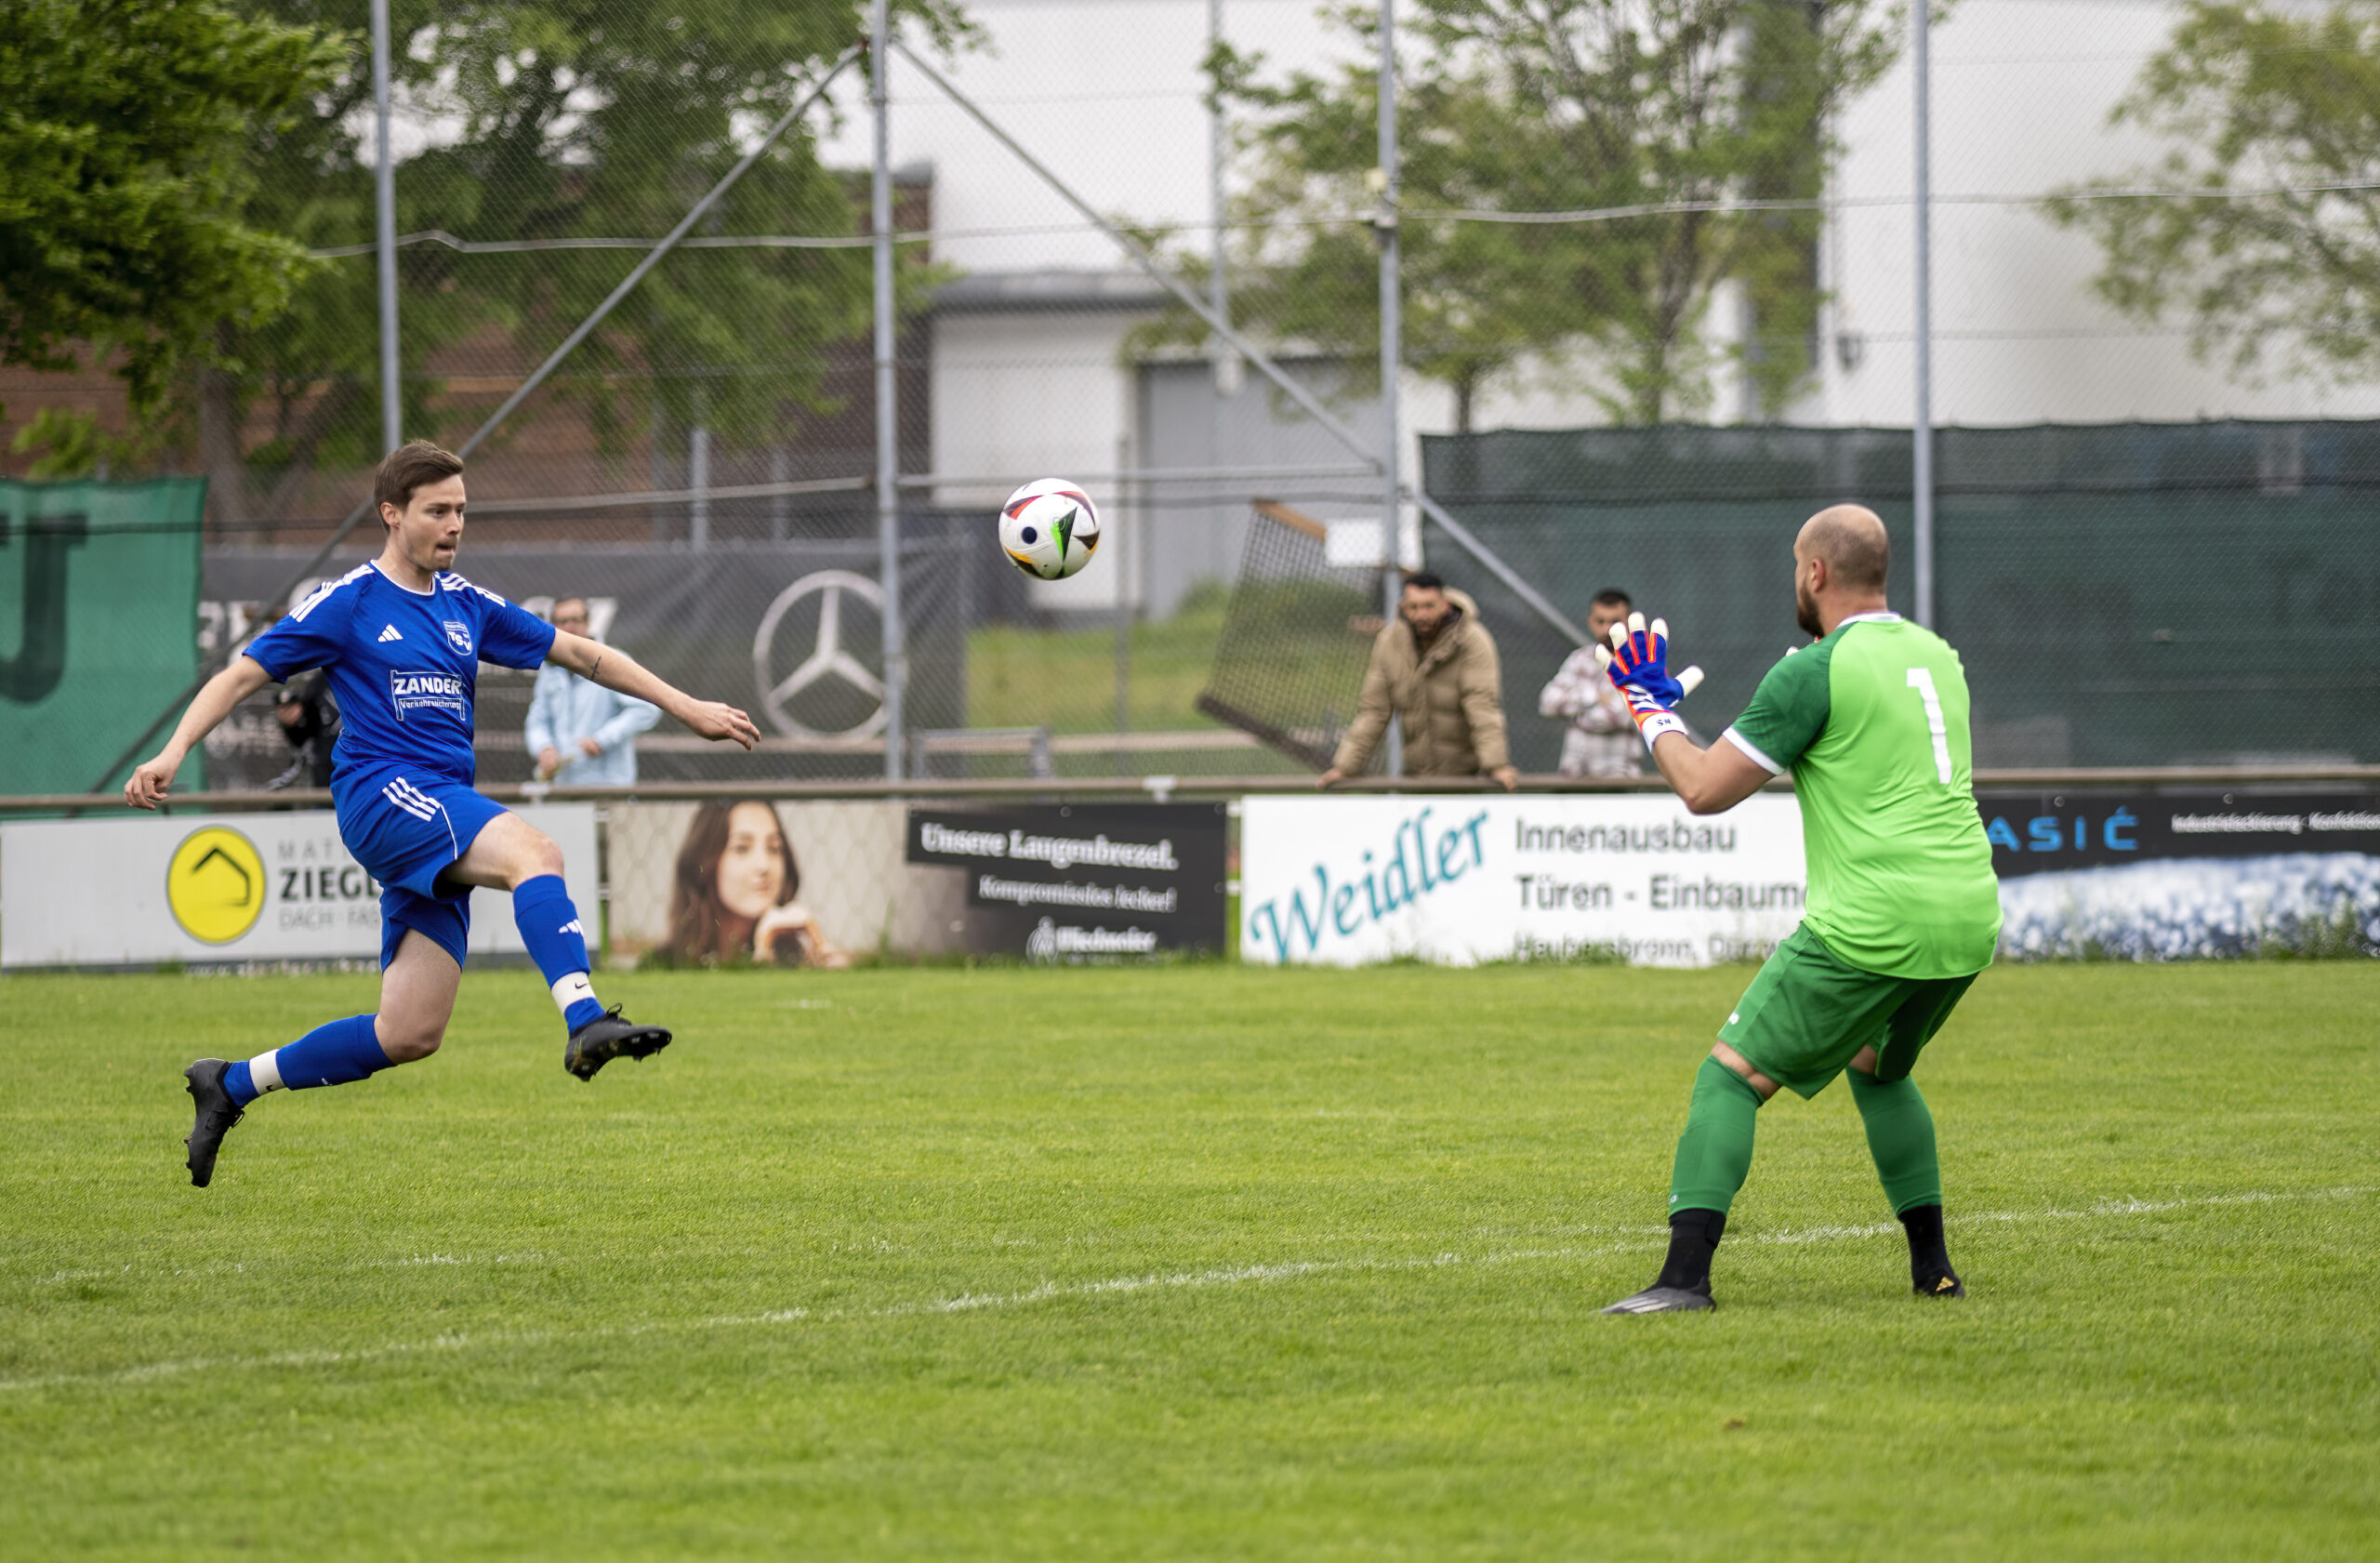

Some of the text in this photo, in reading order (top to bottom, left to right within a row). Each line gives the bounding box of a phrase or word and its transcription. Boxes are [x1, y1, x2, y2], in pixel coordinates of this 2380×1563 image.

[393, 677, 462, 695] ZANDER
[1906, 667, 1952, 785] 1
[921, 822, 1179, 870] Unsere Laugenbrezel.
[1515, 817, 1736, 853] Innenausbau
[1250, 804, 1488, 964] Weidler
[1515, 872, 1613, 910] Türen
